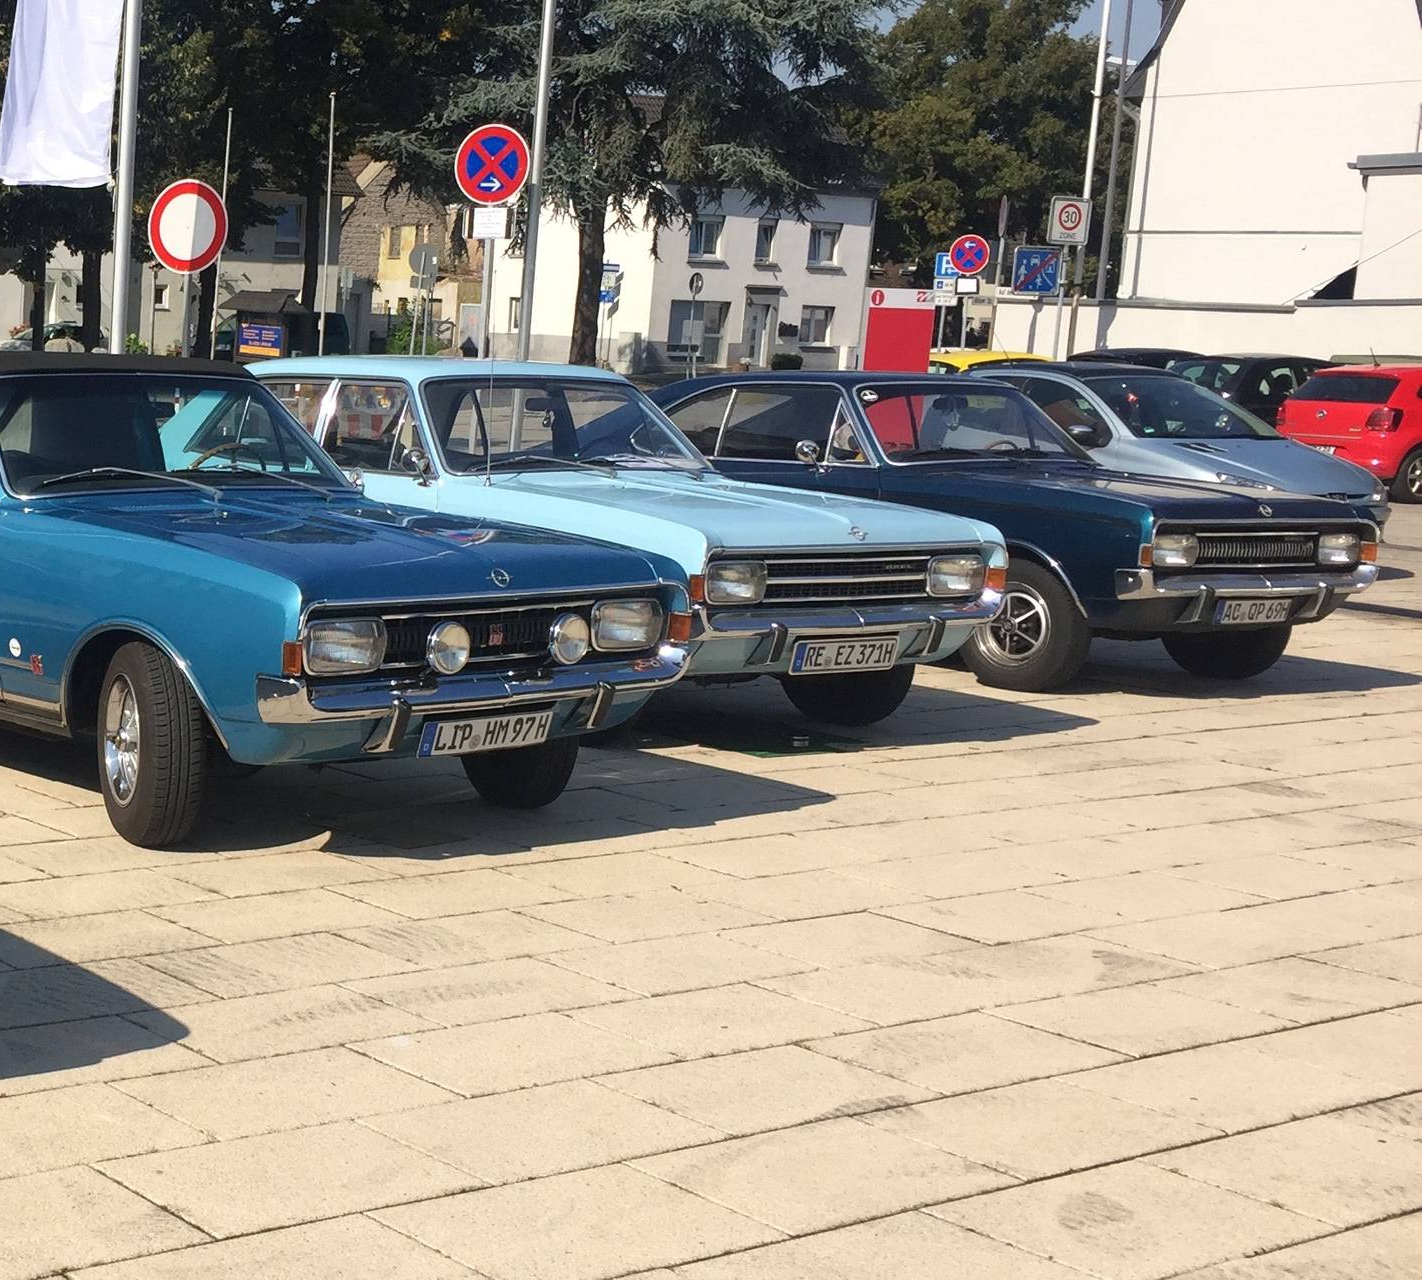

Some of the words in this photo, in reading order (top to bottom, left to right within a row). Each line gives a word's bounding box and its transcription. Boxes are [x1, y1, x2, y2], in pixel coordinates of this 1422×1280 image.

[1063, 210, 1078, 224] 30
[1222, 603, 1242, 621] AC
[804, 646, 827, 668] RE
[834, 644, 856, 666] EZ
[856, 642, 895, 665] 371H
[434, 723, 474, 751] LIP
[482, 719, 510, 746] HM
